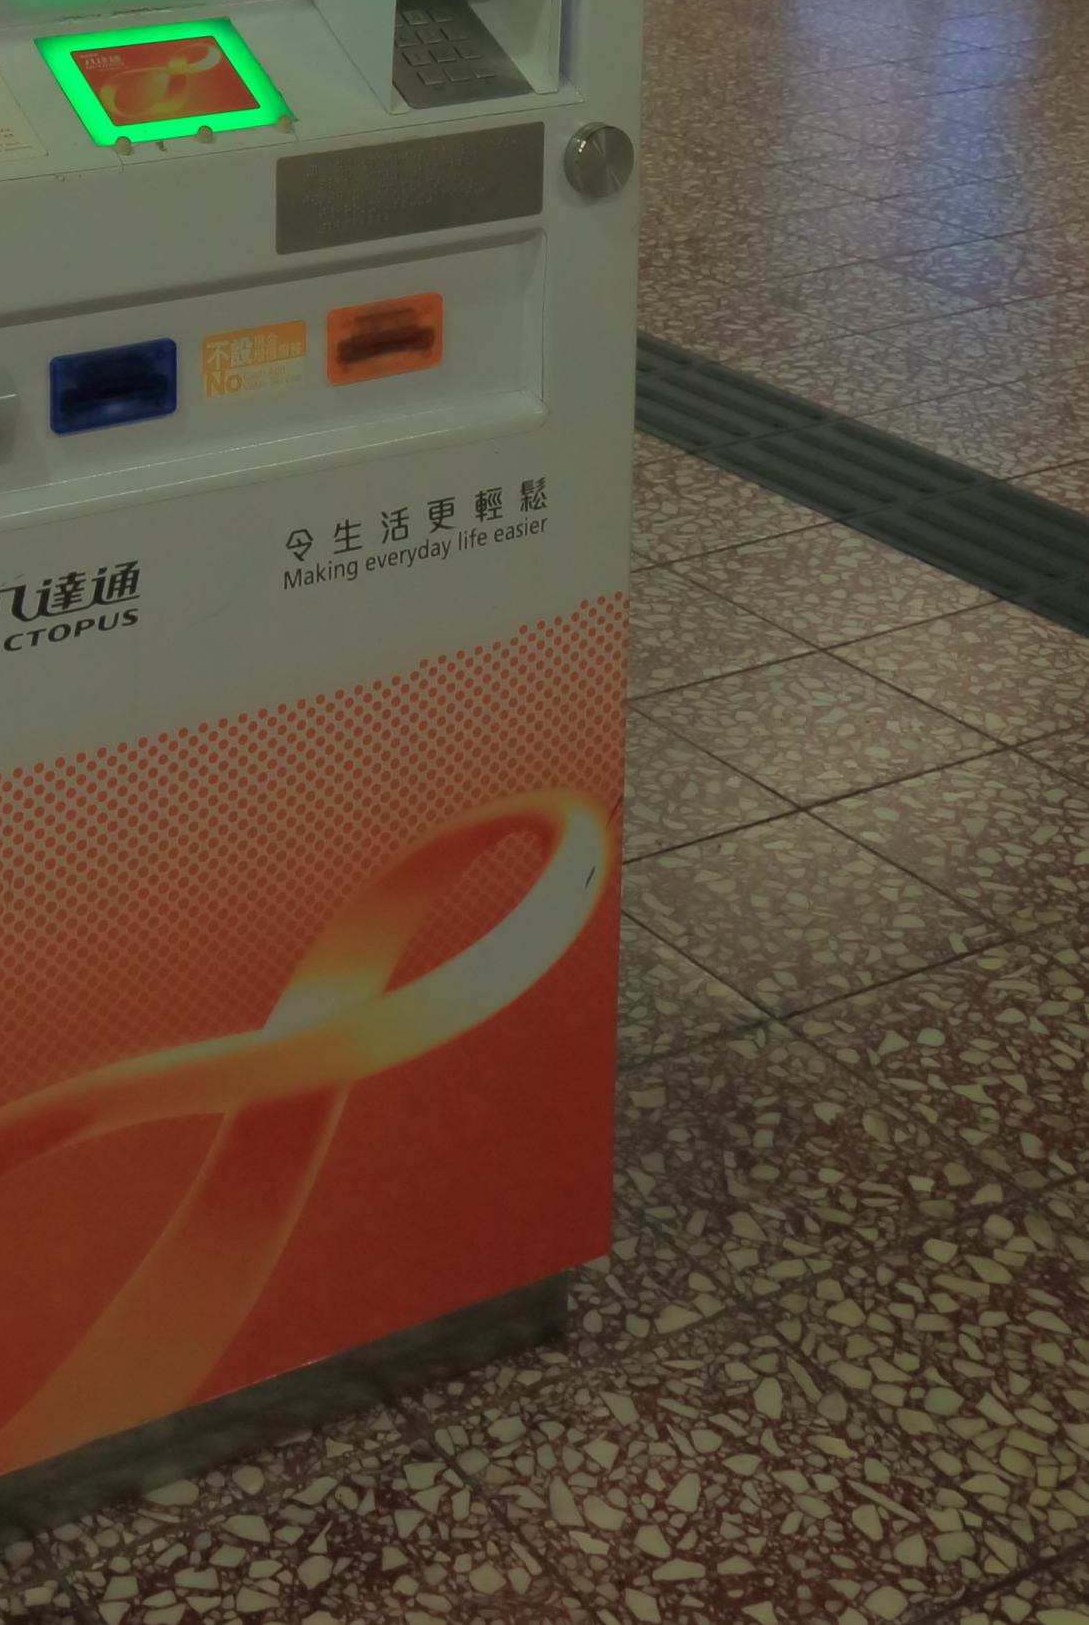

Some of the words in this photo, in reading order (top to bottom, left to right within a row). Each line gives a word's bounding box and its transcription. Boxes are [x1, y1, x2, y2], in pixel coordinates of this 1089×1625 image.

[206, 336, 253, 371] 不設
[254, 342, 303, 363] 增值服務
[206, 371, 243, 399] No
[285, 476, 548, 562] 令生活更輕鬆
[283, 559, 359, 590] Making
[365, 538, 452, 572] everyday
[458, 528, 488, 551] life
[494, 516, 548, 543] easier
